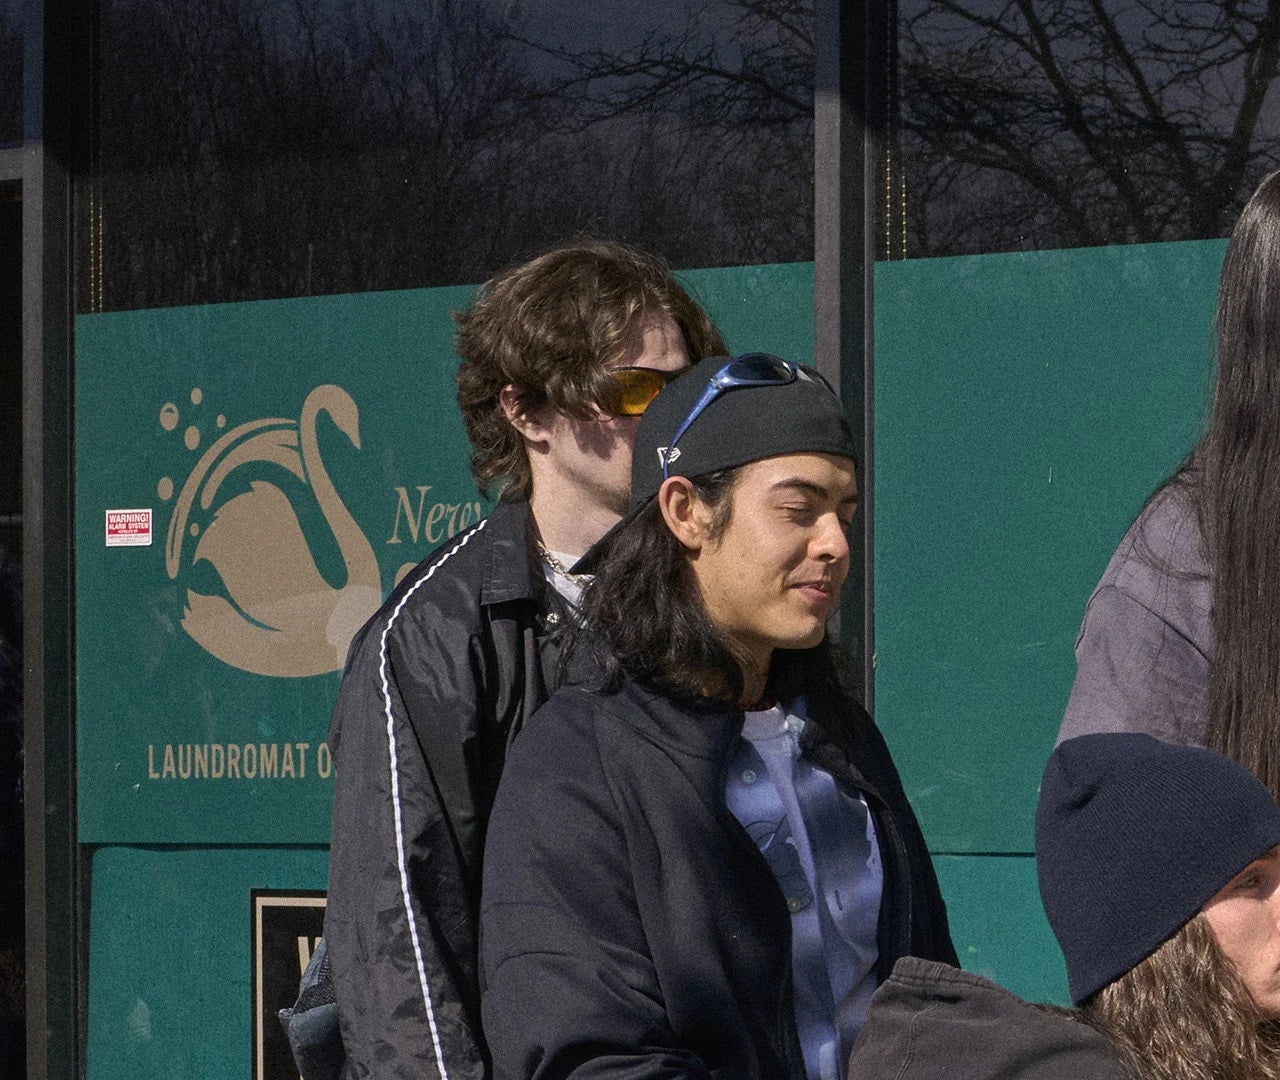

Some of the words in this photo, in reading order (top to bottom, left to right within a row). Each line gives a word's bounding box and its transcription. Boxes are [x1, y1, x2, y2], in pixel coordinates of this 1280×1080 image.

[108, 513, 149, 523] WARNING!
[108, 522, 127, 530] ALARM
[128, 522, 149, 530] SYSTEM
[148, 743, 309, 779] LAUNDROMAT
[317, 742, 332, 779] O
